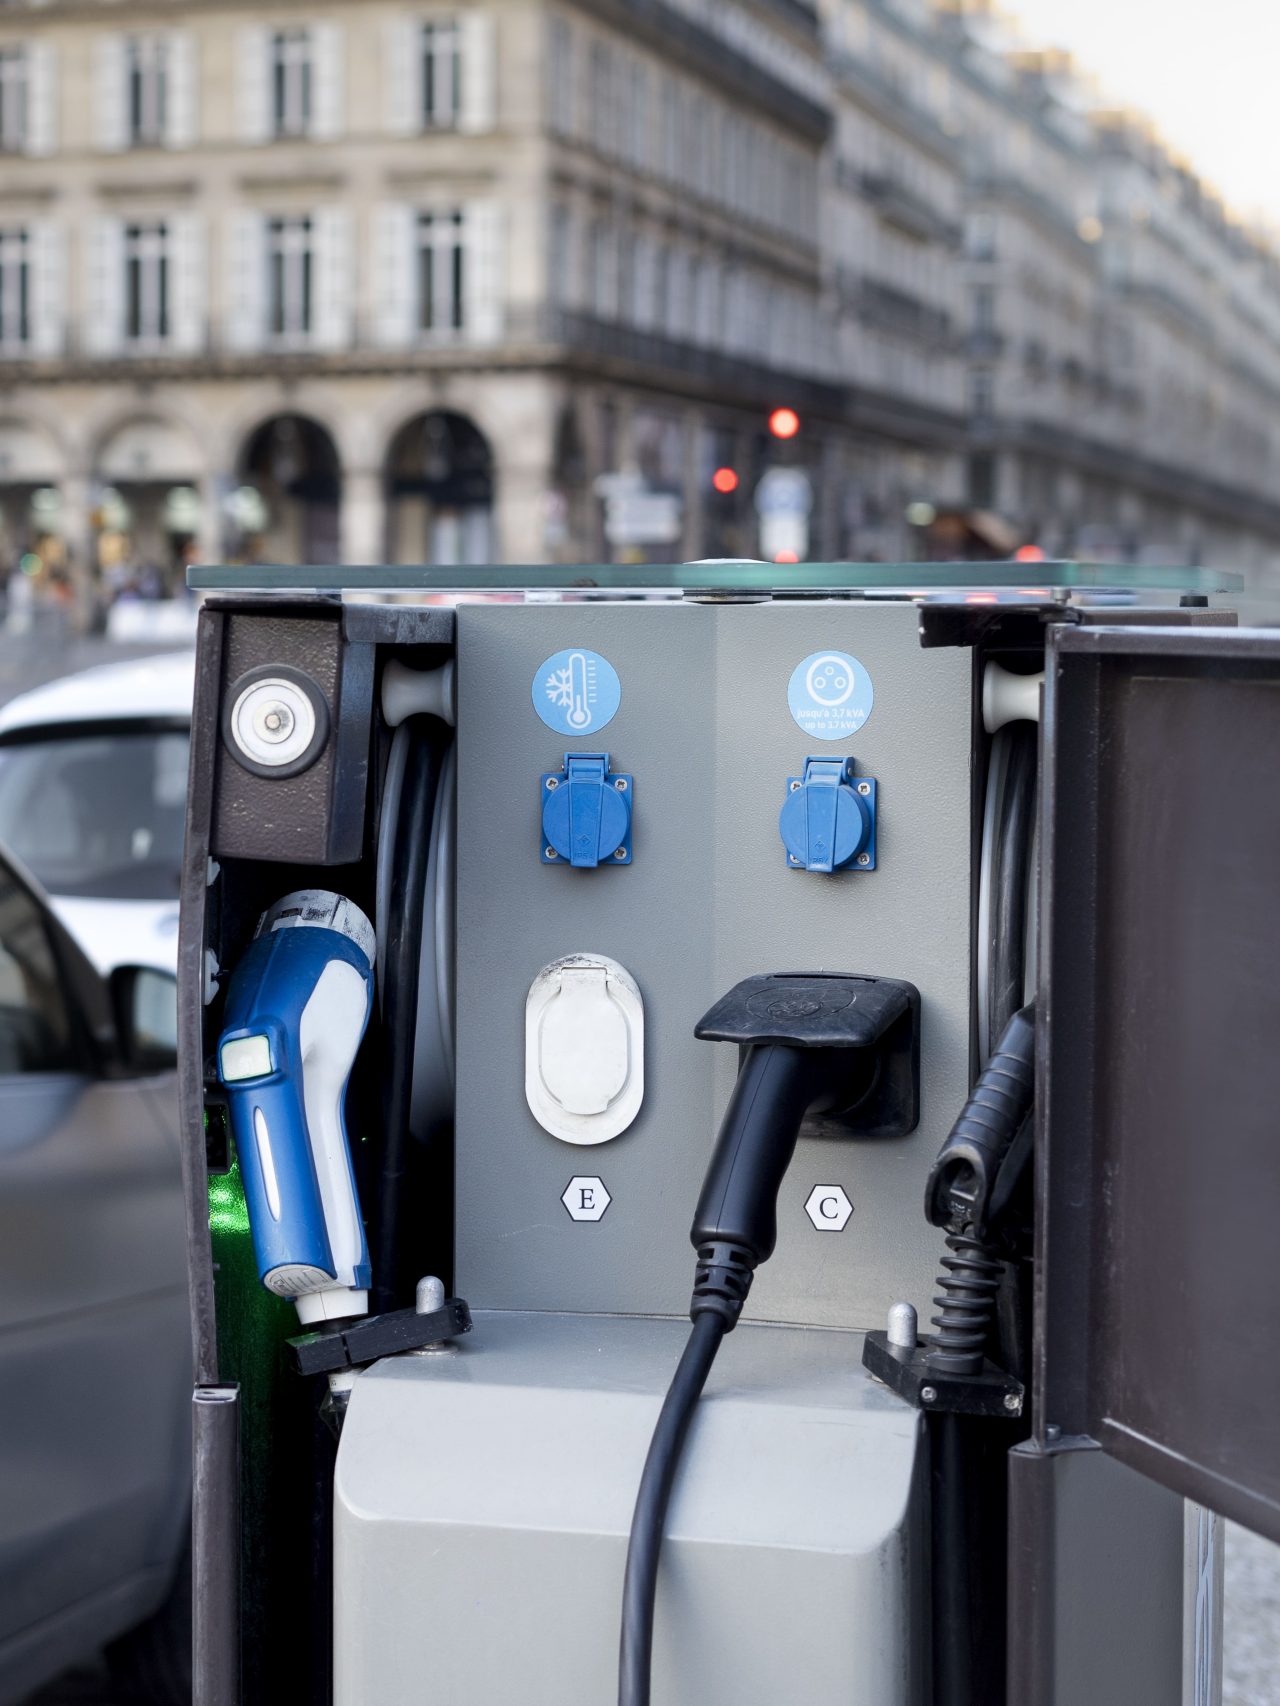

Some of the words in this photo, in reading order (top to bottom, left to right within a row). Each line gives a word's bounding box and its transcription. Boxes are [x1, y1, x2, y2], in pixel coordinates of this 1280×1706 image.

[847, 707, 865, 718] kVA
[805, 720, 816, 730] up
[817, 720, 826, 729] to
[578, 1188, 596, 1210] E
[819, 1196, 839, 1220] C
